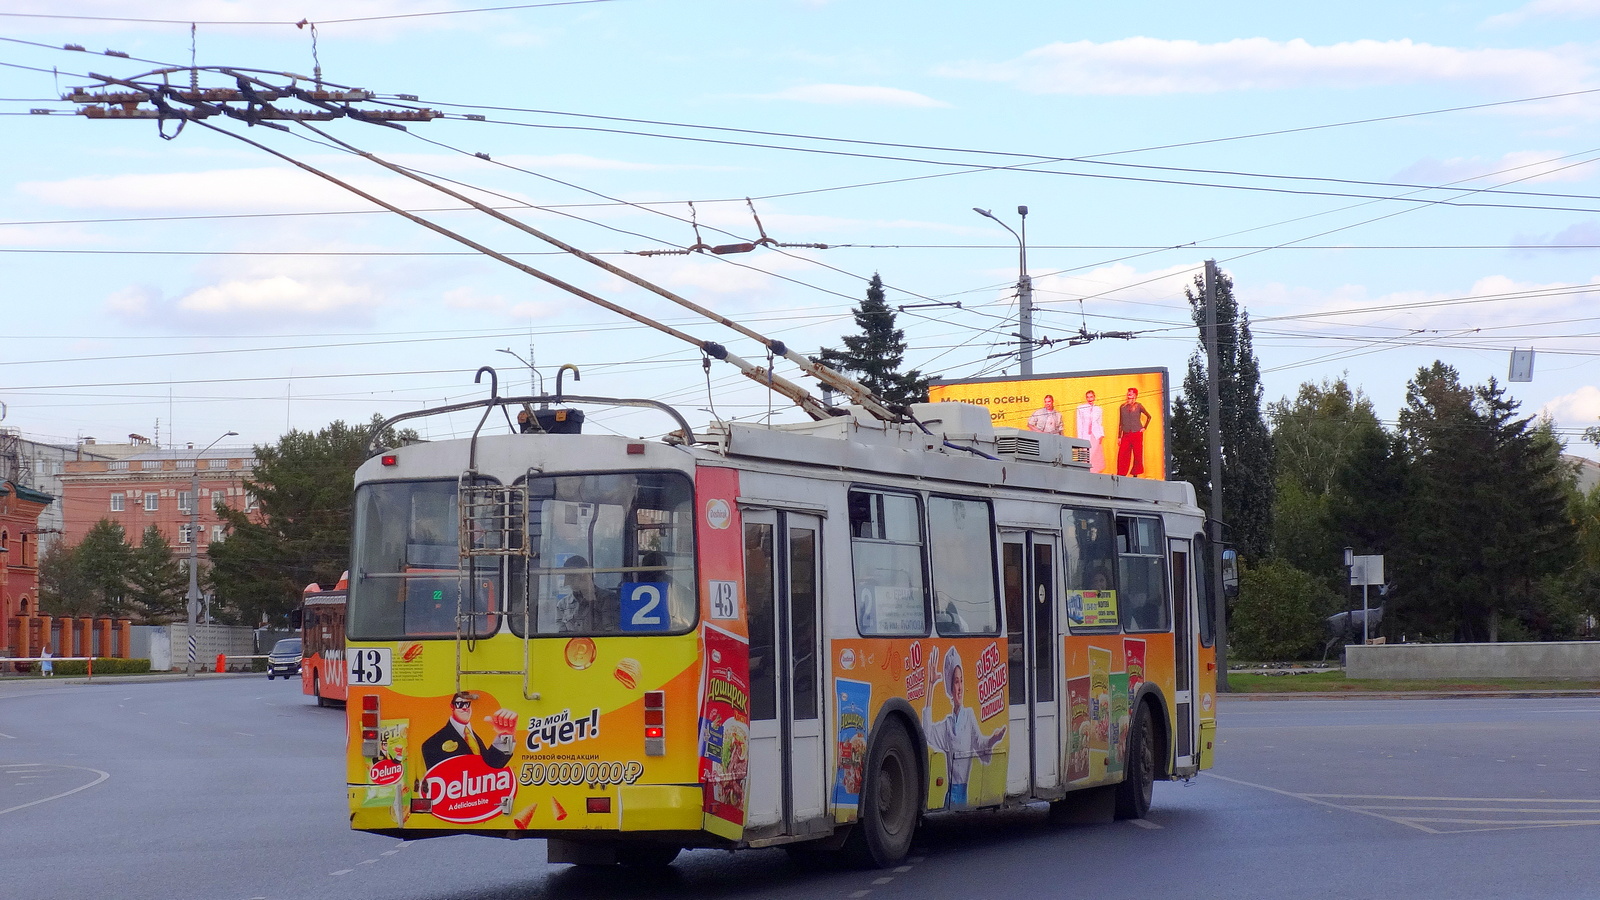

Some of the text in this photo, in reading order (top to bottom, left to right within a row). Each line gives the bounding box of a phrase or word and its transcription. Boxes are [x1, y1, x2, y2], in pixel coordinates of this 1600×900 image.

[994, 396, 1029, 404] осень
[433, 590, 443, 600] 22
[631, 585, 660, 625] 2
[715, 583, 733, 617] 43
[352, 650, 382, 684] 43
[911, 642, 922, 669] 10
[982, 644, 999, 674] 15%
[978, 666, 1007, 702] БОЛЬШЕ
[527, 708, 598, 750] счет!
[529, 710, 569, 730] За мой
[371, 765, 402, 780] Deluna
[425, 770, 510, 806] Deluna
[454, 800, 478, 810] delicious
[477, 798, 489, 806] bite
